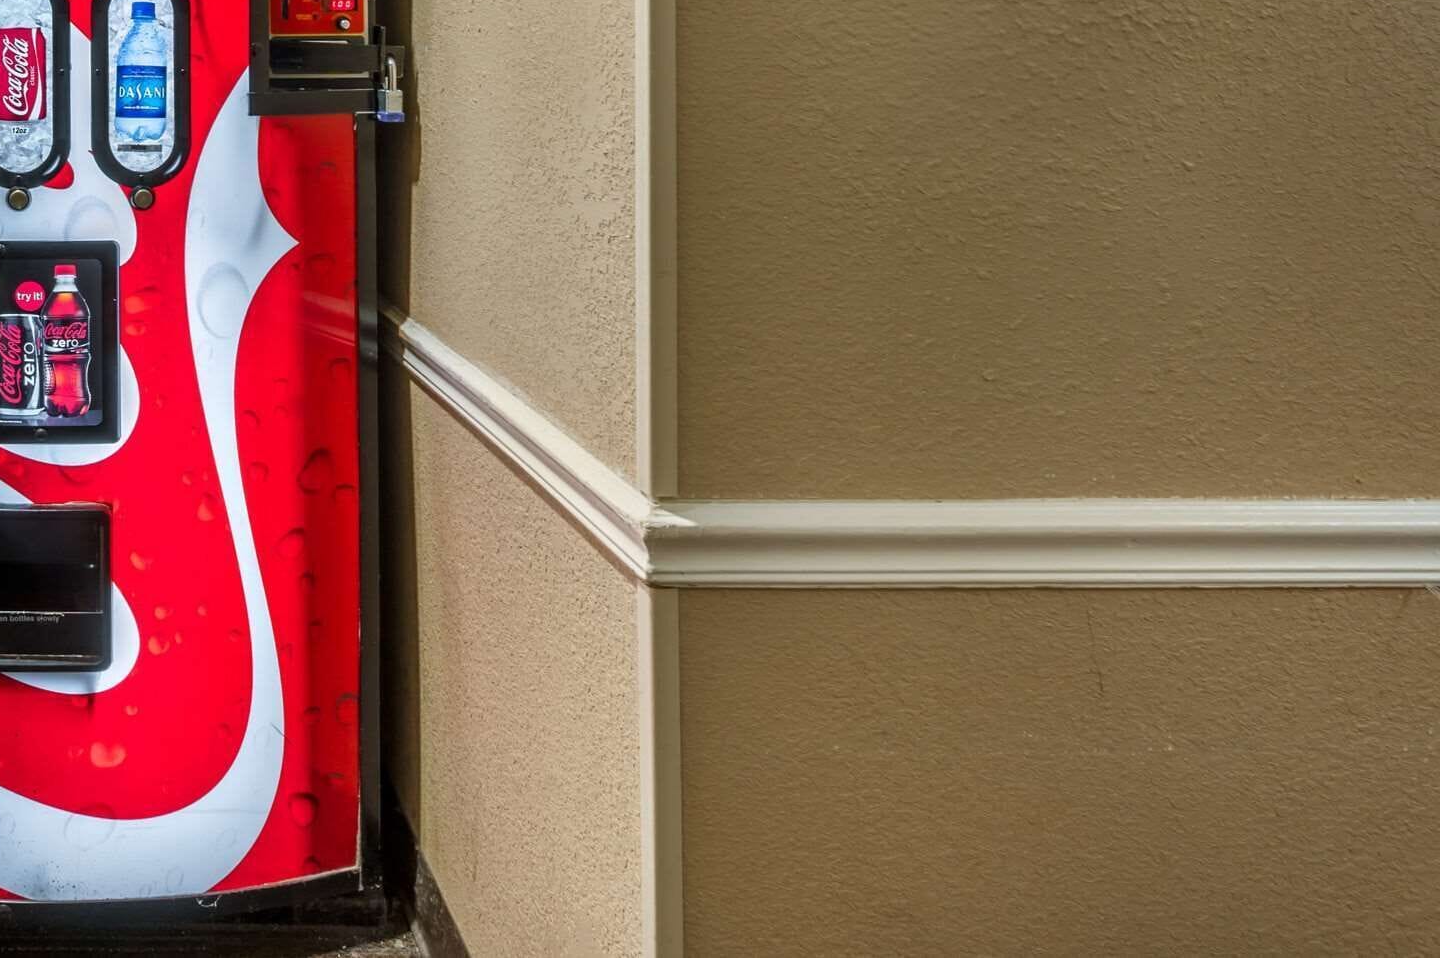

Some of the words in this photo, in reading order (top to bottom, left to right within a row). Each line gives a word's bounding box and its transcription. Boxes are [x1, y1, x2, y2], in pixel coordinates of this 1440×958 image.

[2, 33, 29, 116] Coca-Cola
[119, 82, 165, 101] DASANI
[16, 292, 32, 302] try
[33, 291, 44, 301] it!
[51, 338, 80, 348] zero
[23, 342, 36, 387] zero
[9, 615, 35, 623] bottles
[36, 615, 61, 624] slowly
